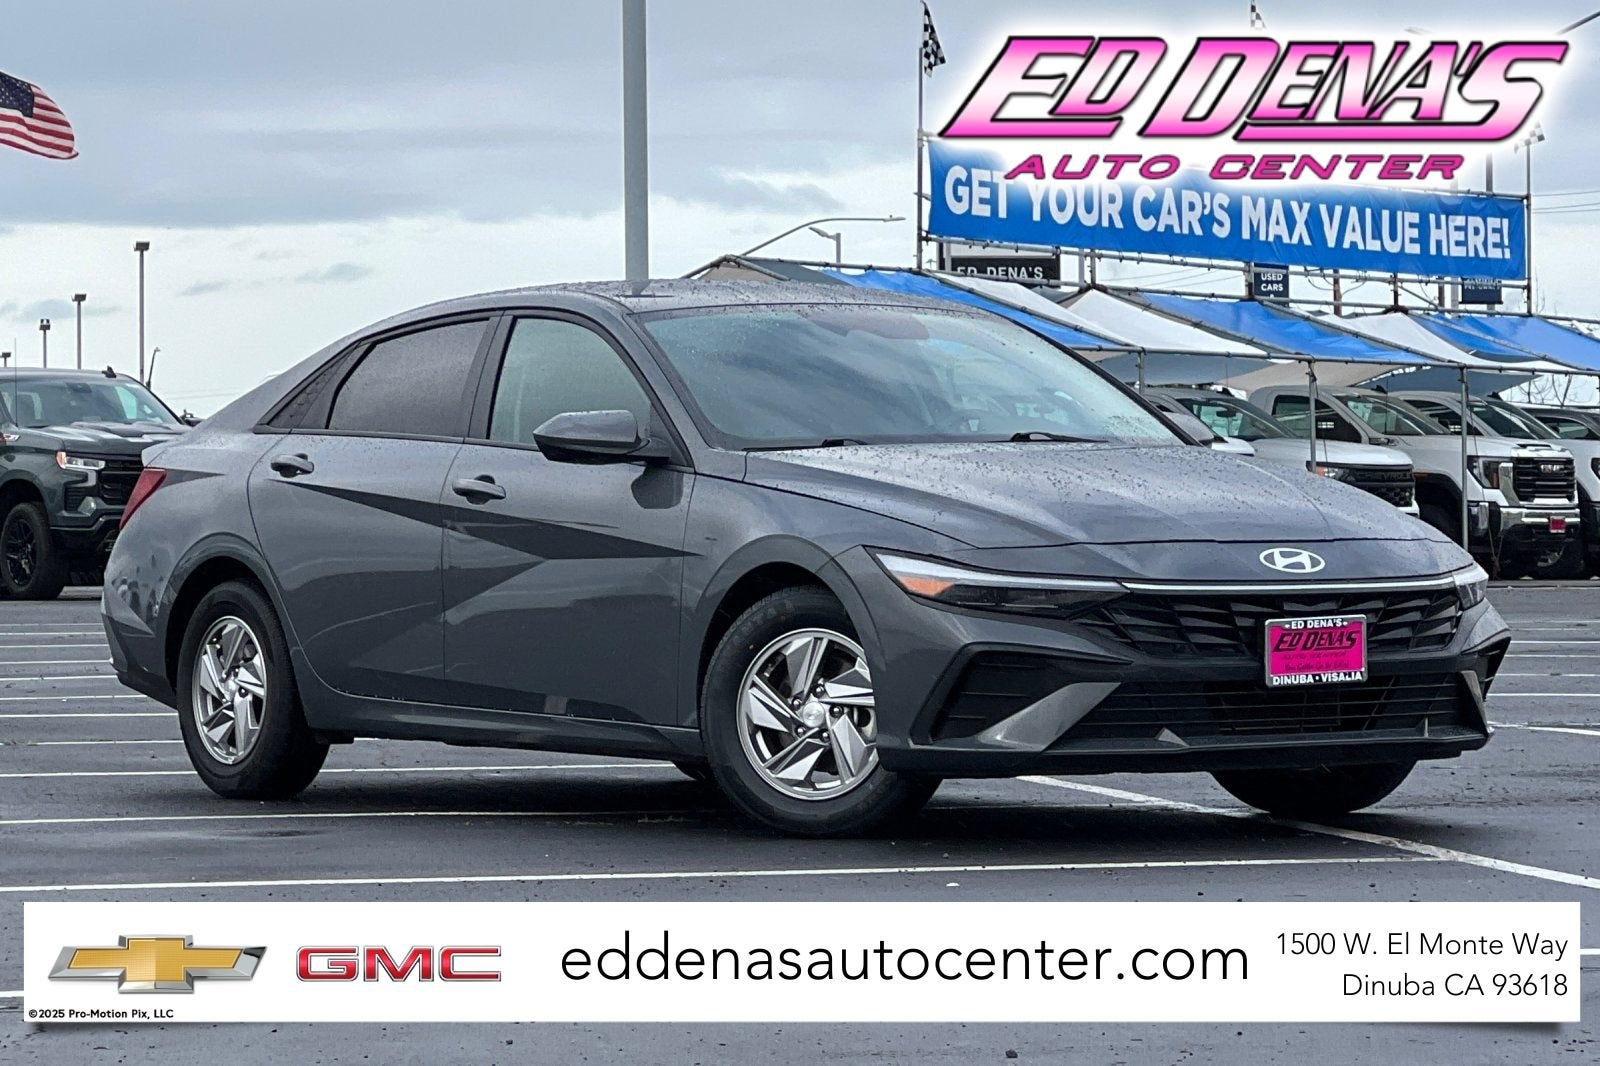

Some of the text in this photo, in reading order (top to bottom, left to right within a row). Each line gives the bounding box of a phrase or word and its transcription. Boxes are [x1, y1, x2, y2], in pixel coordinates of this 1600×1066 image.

[945, 165, 1511, 259] GET YOUR CAR'S MAX VALUE HERE!
[987, 266, 1043, 279] DENA'S
[1260, 273, 1284, 281] USED
[1260, 283, 1284, 292] CARS
[1291, 618, 1343, 629] ED DENA'S
[1273, 630, 1360, 652] ED DENA'S
[1273, 671, 1363, 685] DINUBA VISALIA
